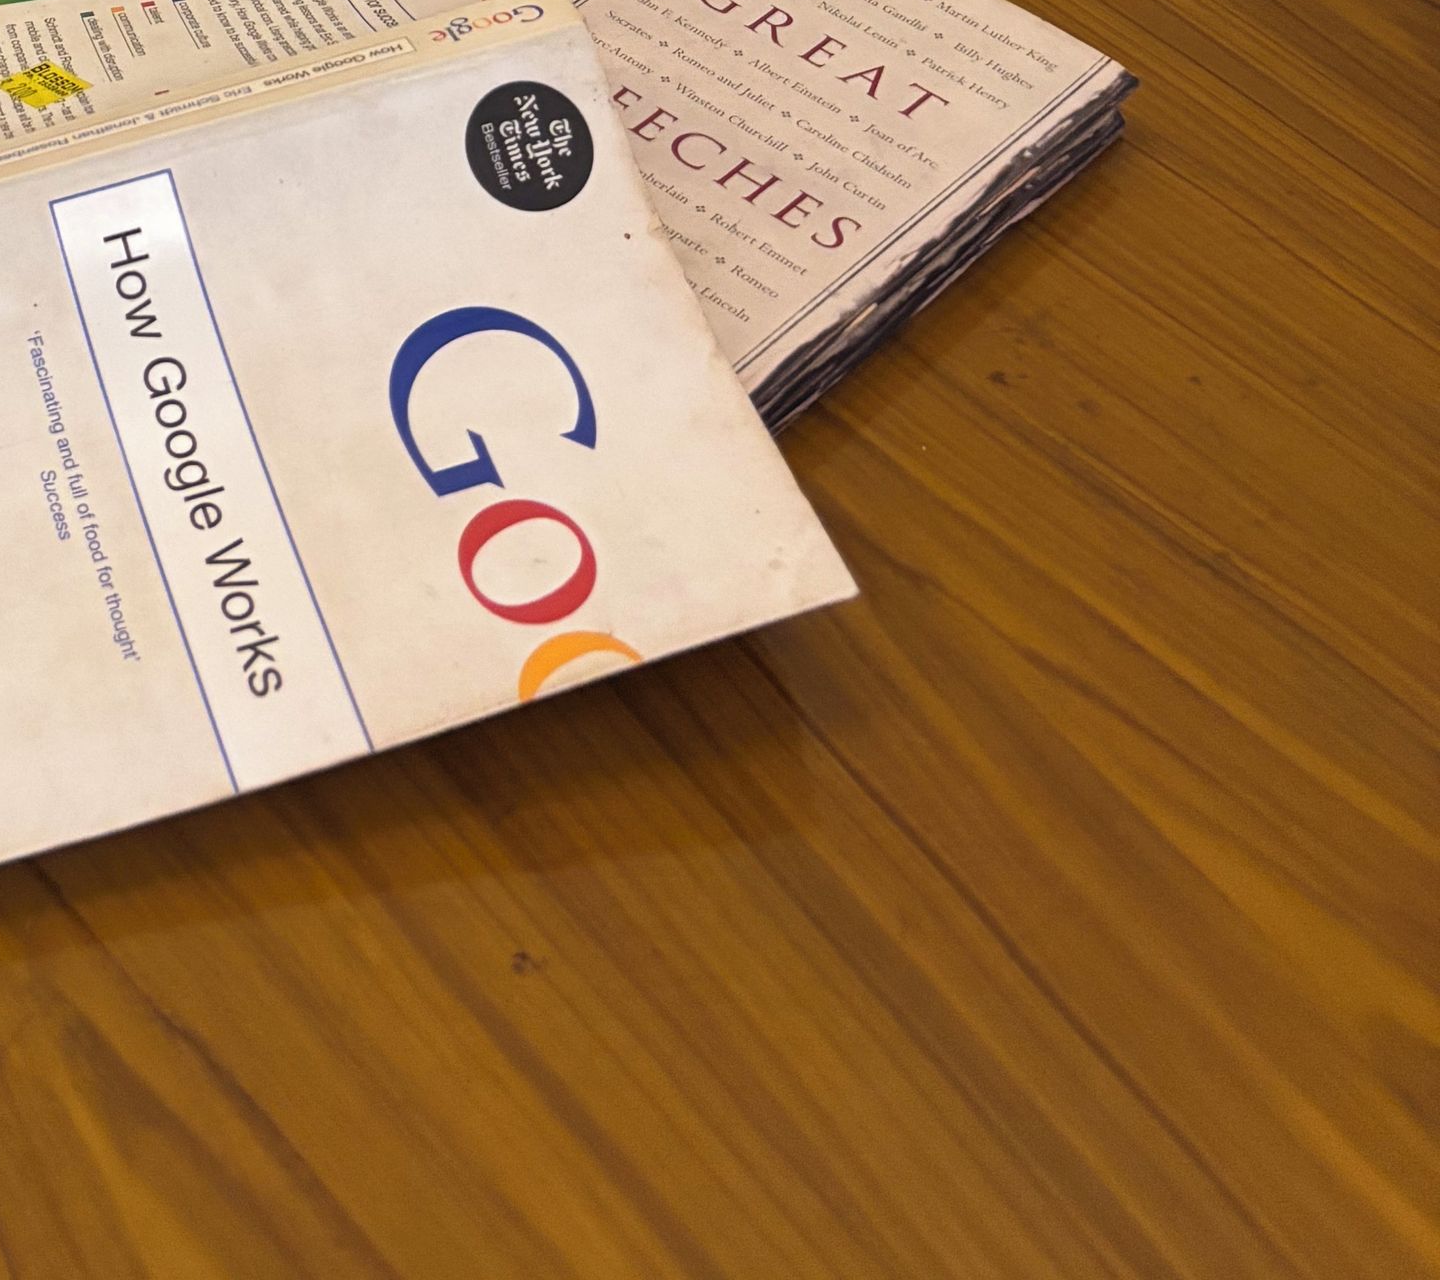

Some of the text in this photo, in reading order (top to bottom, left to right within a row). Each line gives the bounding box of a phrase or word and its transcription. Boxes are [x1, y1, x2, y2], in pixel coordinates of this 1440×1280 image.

[43, 16, 69, 56] Schmidt and
[117, 12, 146, 56] communication
[178, 1, 211, 48] corporate culture
[428, 4, 544, 42] Google
[935, 1, 979, 28] Martin
[980, 24, 1025, 51] Luther
[1025, 48, 1058, 72] King
[86, 17, 123, 81] dealing with disruption
[258, 43, 403, 86] How Google Works
[816, 0, 863, 29] Nikolai
[862, 25, 907, 48] Lenin
[920, 56, 967, 86] Patrick
[968, 82, 1010, 110] Henry
[881, 4, 928, 31] Gandhi
[953, 42, 983, 63] Billy
[984, 59, 1034, 90] Hughes
[31, 63, 83, 94] BLOSSOM
[604, 10, 911, 189] Socrates Romeo and Juliet Caroline Chisholm
[673, 15, 729, 50] Kennedy
[747, 58, 791, 85] Albert
[790, 81, 841, 114] Einstein
[861, 123, 894, 144] Joan
[896, 143, 915, 153] of
[911, 146, 938, 170] Arc
[499, 119, 531, 182] Times
[513, 93, 564, 191] New York
[549, 117, 573, 157] The
[609, 47, 654, 75] Antony
[675, 81, 725, 117] Winston
[727, 114, 789, 152] Churchill
[804, 161, 839, 184] John
[842, 181, 886, 210] Curtin
[481, 122, 512, 190] Bestseller
[709, 213, 757, 245] Robert
[757, 242, 808, 276] Emmet
[694, 286, 750, 323] Lincoln
[729, 264, 779, 298] Romeo
[56, 437, 79, 471] and
[102, 227, 282, 698] How Google Works
[39, 470, 70, 541] Success
[66, 473, 88, 499] full
[76, 502, 95, 520] of
[82, 523, 108, 563] food
[95, 565, 114, 589] for
